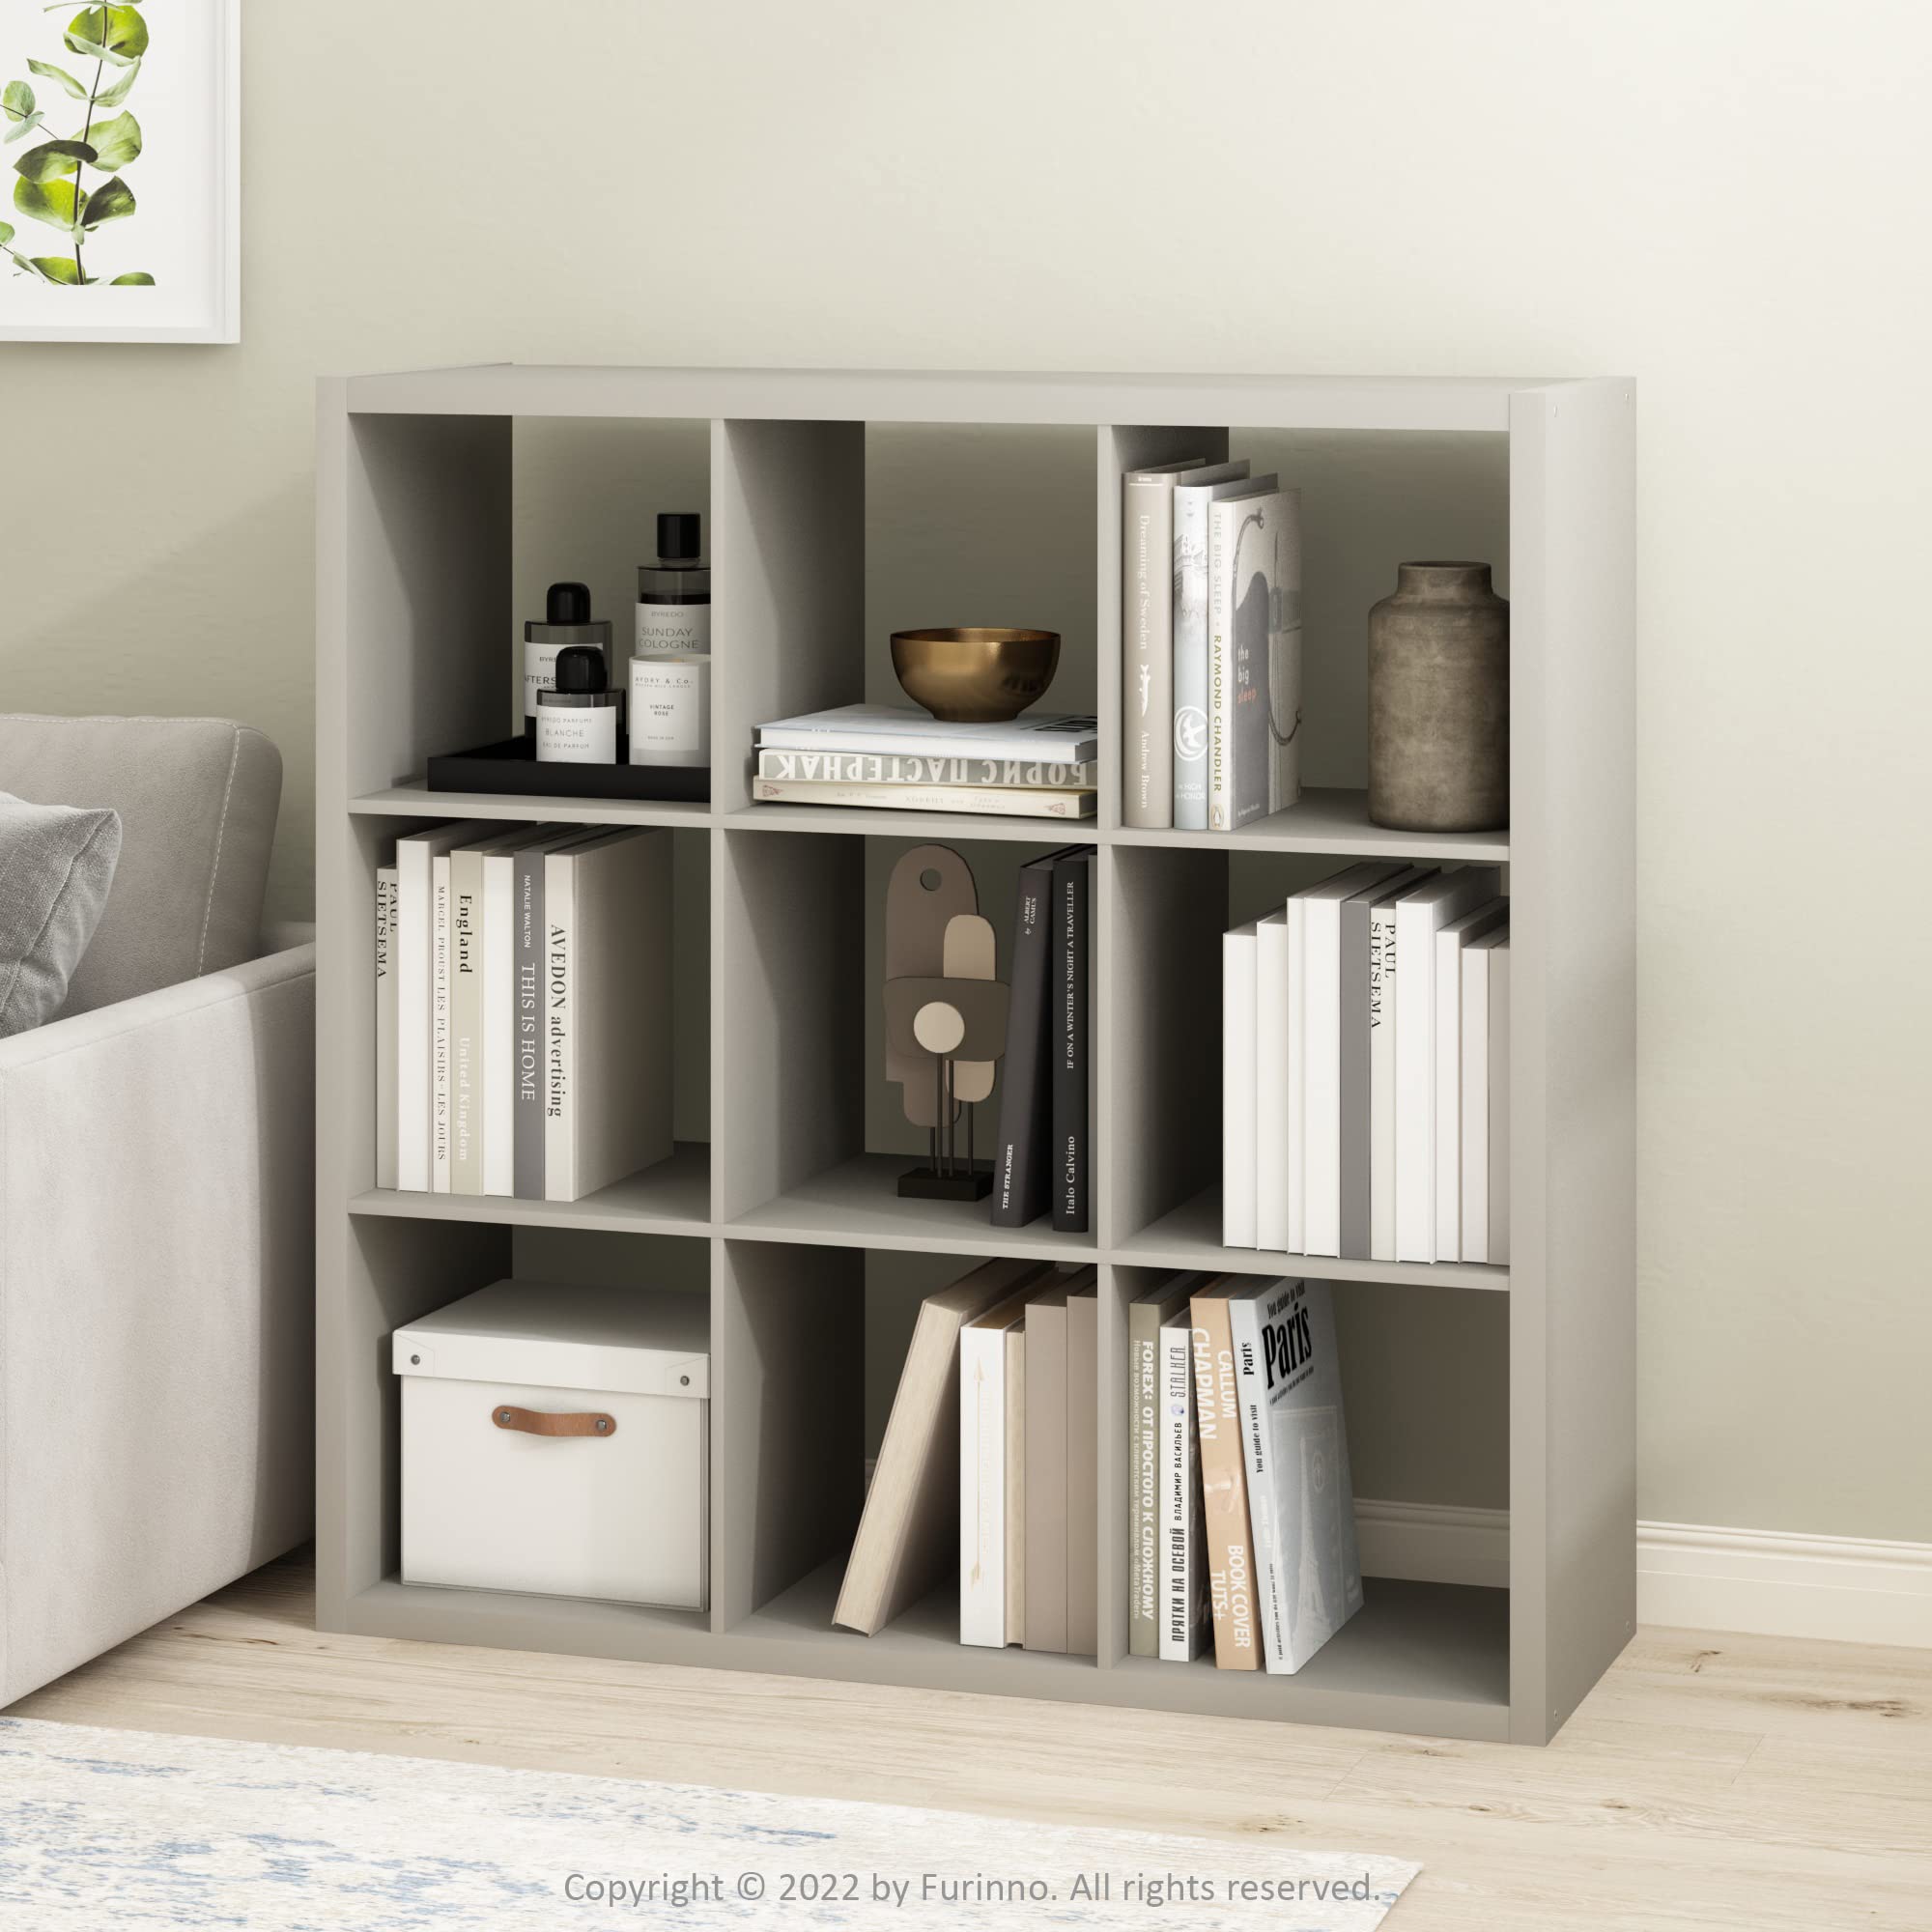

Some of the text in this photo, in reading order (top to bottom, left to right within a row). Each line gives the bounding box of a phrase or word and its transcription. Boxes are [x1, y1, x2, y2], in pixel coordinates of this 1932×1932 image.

[1137, 515, 1151, 650] Dreaming of Sweden
[1213, 513, 1222, 615] THE BIG SLEEP
[639, 639, 699, 649] COLOGNE
[641, 626, 694, 638] SUNDAY
[545, 727, 584, 738] BLANCHE
[1213, 635, 1222, 791] RAYMOND CHANDLER
[776, 753, 1088, 786] БОРИС ПАСТЕРНАК
[1141, 730, 1151, 809] Andrew Brown
[377, 880, 387, 978] SIETSEMA
[389, 883, 398, 933] PAUL
[437, 885, 445, 931] MARCEL
[455, 895, 473, 974] England
[523, 874, 532, 949] NATALIE WALTON
[437, 937, 445, 981] PROUST
[1066, 940, 1074, 949] A
[1384, 924, 1396, 979] PAUL
[437, 986, 445, 1010] LES
[1371, 922, 1381, 1029] SIETSEMA
[521, 963, 535, 1100] THIS IS HOME
[547, 924, 567, 1118] AVEDON advertising
[1066, 1033, 1074, 1041] A
[1066, 1042, 1074, 1058] ON
[1066, 1059, 1074, 1069] IF
[437, 1093, 446, 1116] LES
[457, 1037, 471, 1161] United Kingdom
[438, 1121, 446, 1160] JOURS
[1004, 1144, 1013, 1190] STRANGER
[1065, 1135, 1075, 1215] Italo Calvino
[1241, 1342, 1255, 1377] Paris
[1262, 1301, 1313, 1390] Paris
[1192, 1326, 1218, 1439] CHAPMAN
[1217, 1350, 1237, 1419] CALLUM
[1252, 1422, 1259, 1432] to
[1253, 1433, 1264, 1458] guide
[1142, 1341, 1154, 1620] FOREX: ОТ ПРОСТОГО К СЛОЖНОМУ
[1174, 1422, 1182, 1520] ВЛАДИМИР ВАСИЛЬЕВ
[1169, 1527, 1185, 1642] ПРЯТКИ НА ОСЕВОЙ
[1210, 1570, 1230, 1620] TUTS+
[1227, 1545, 1252, 1649] BOOK COVER
